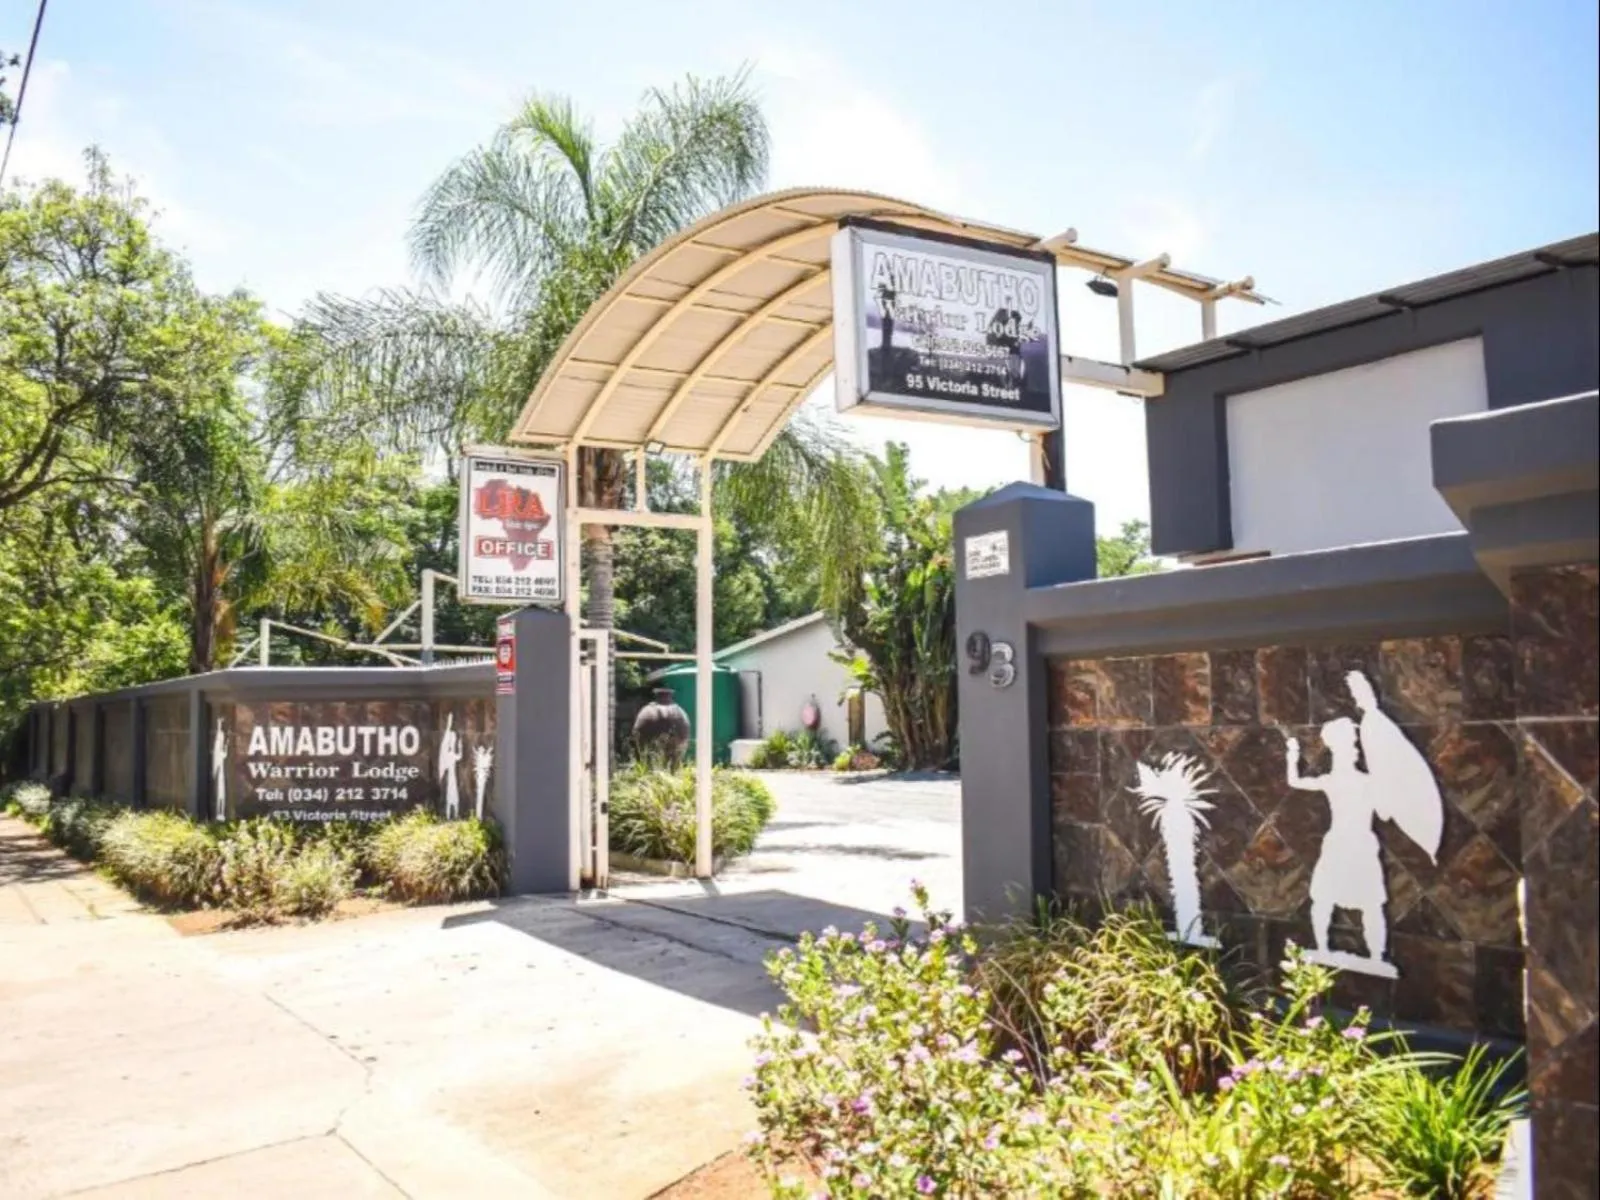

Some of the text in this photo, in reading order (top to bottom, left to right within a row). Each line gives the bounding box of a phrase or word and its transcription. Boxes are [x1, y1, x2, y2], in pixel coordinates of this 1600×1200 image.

[870, 252, 1041, 316] AMABUTHO
[974, 311, 1042, 346] Lodge
[906, 373, 1021, 401] 95 Victoria Street
[481, 540, 549, 557] OFFICE
[966, 630, 1016, 689] 93
[247, 725, 420, 756] AMABUTHO
[247, 761, 420, 782] Warrior Lodge
[256, 788, 408, 803] Tel: (034) 212 3714
[293, 809, 347, 821] Victoria
